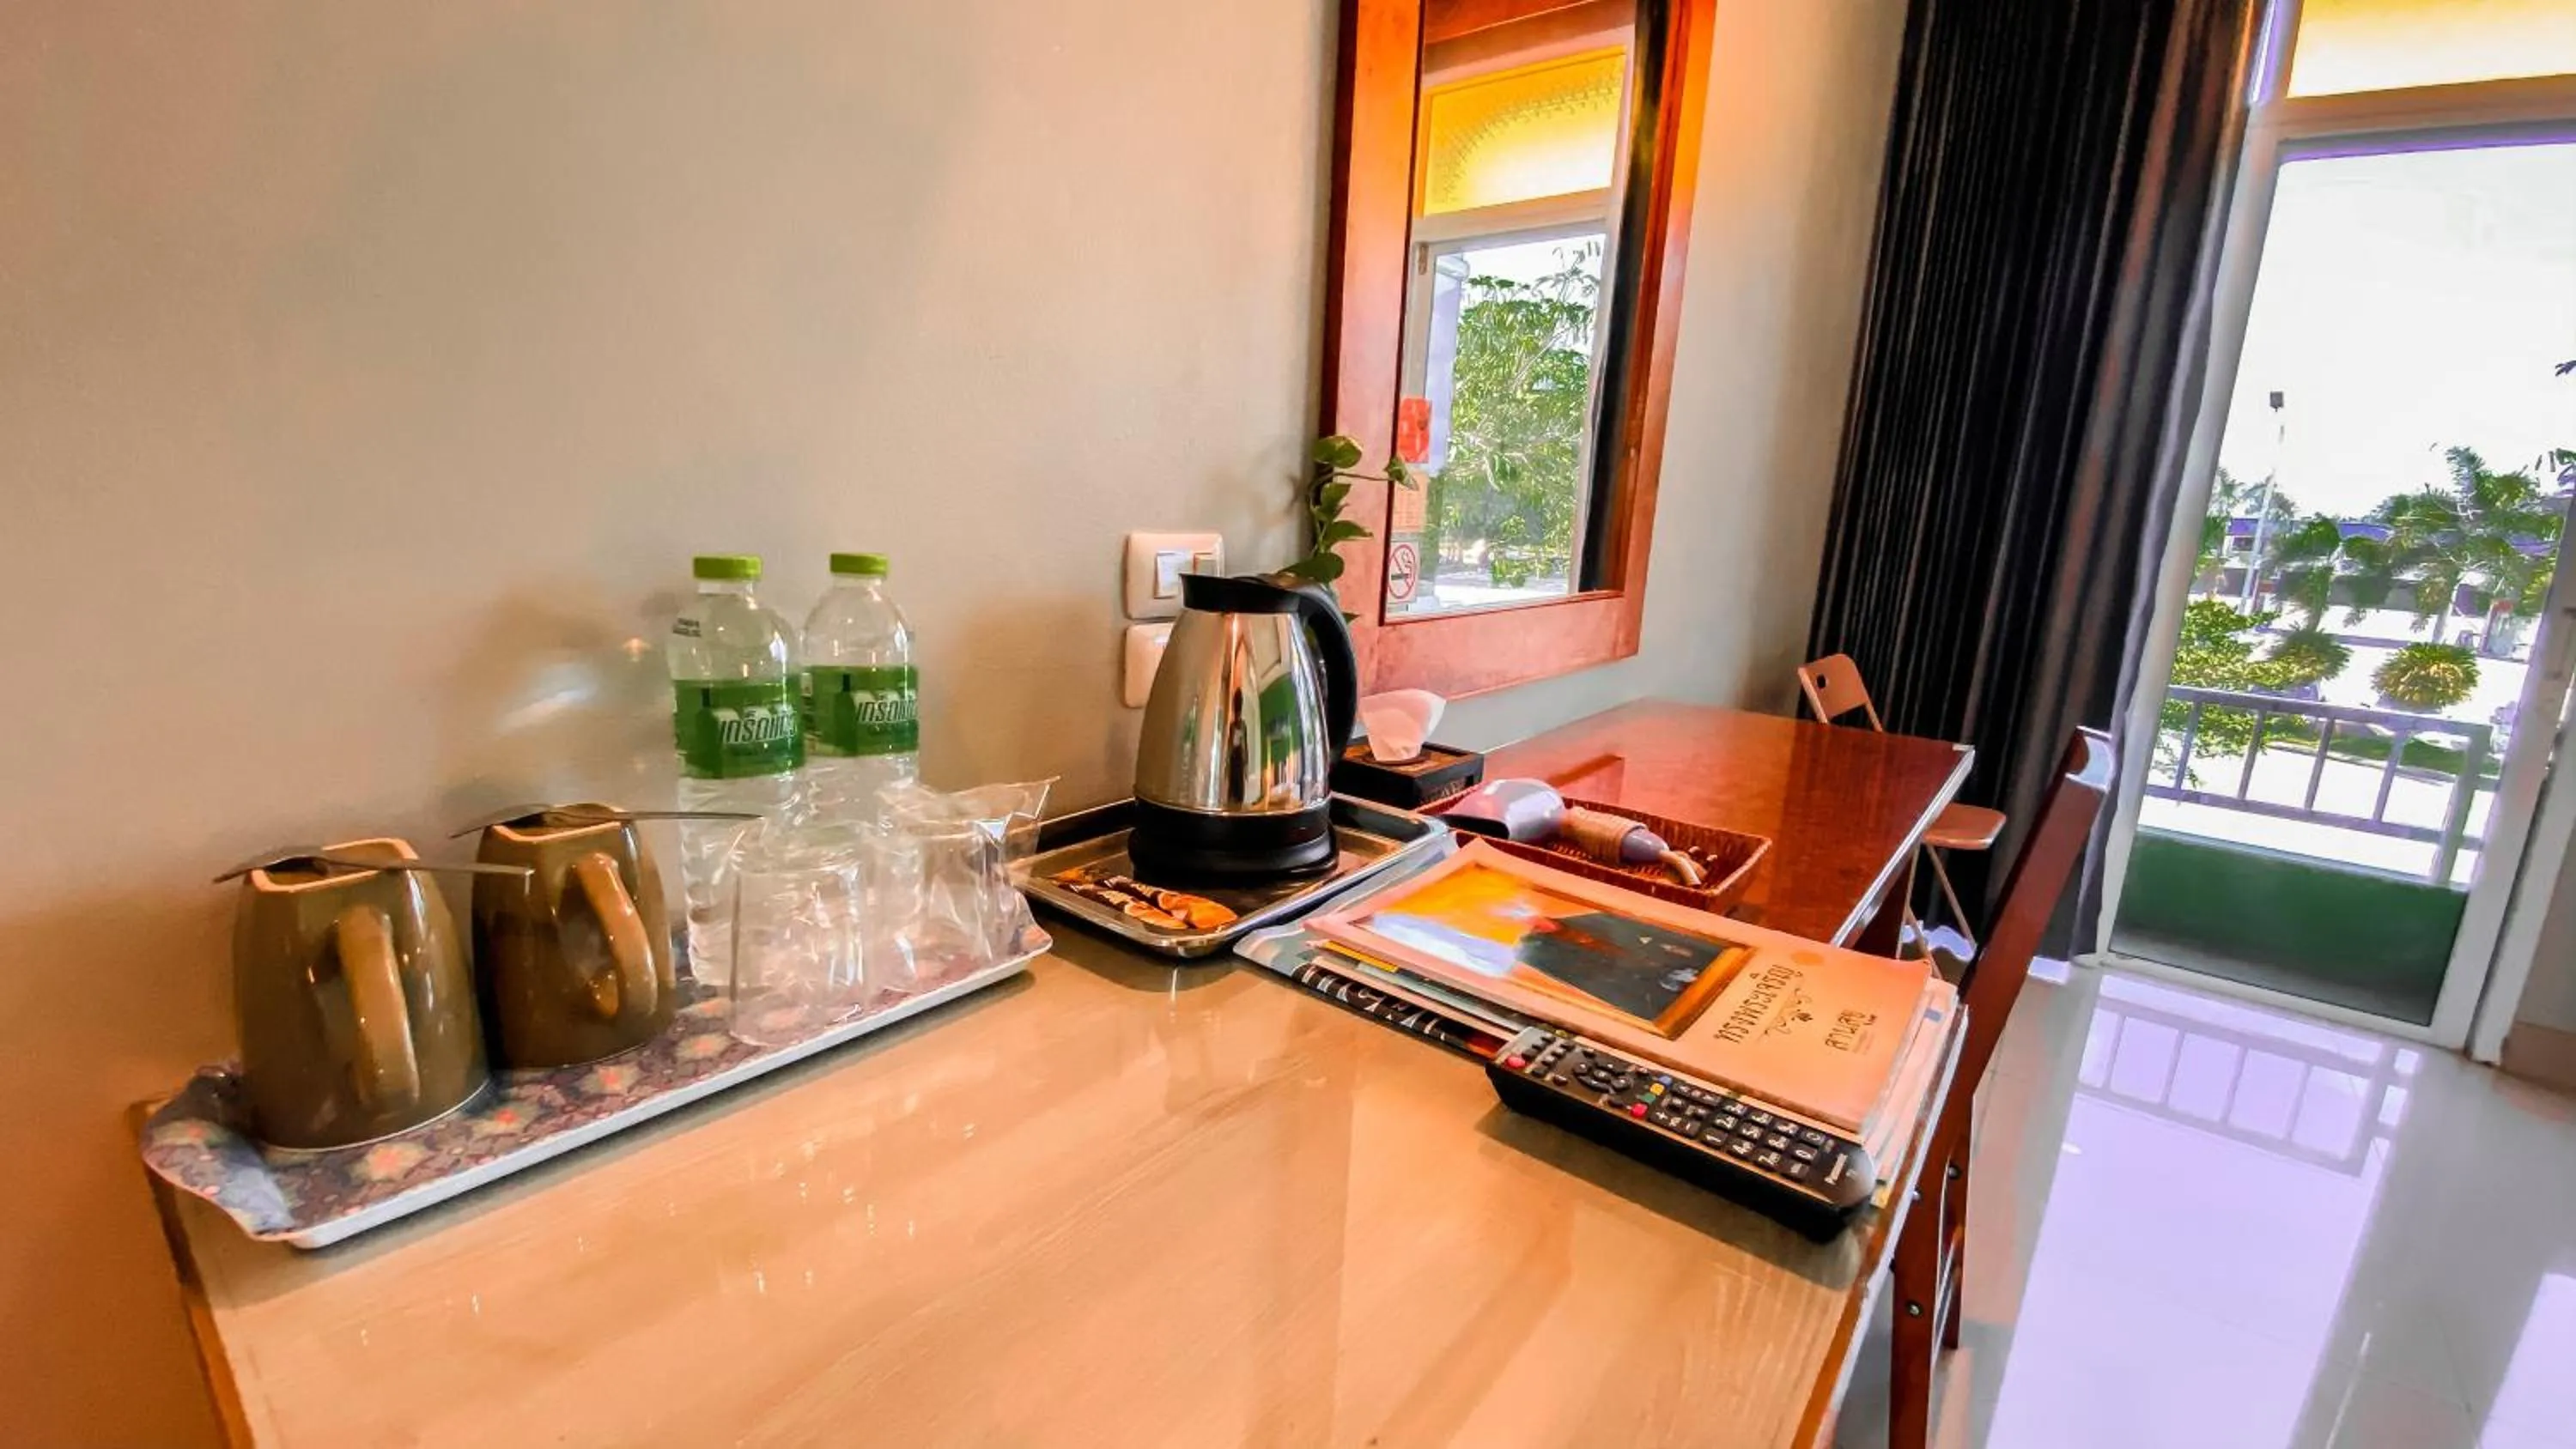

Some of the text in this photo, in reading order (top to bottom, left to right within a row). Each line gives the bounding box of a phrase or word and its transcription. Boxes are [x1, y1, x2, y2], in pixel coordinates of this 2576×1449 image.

[1714, 964, 1803, 1044] ทรงพระเจริญ
